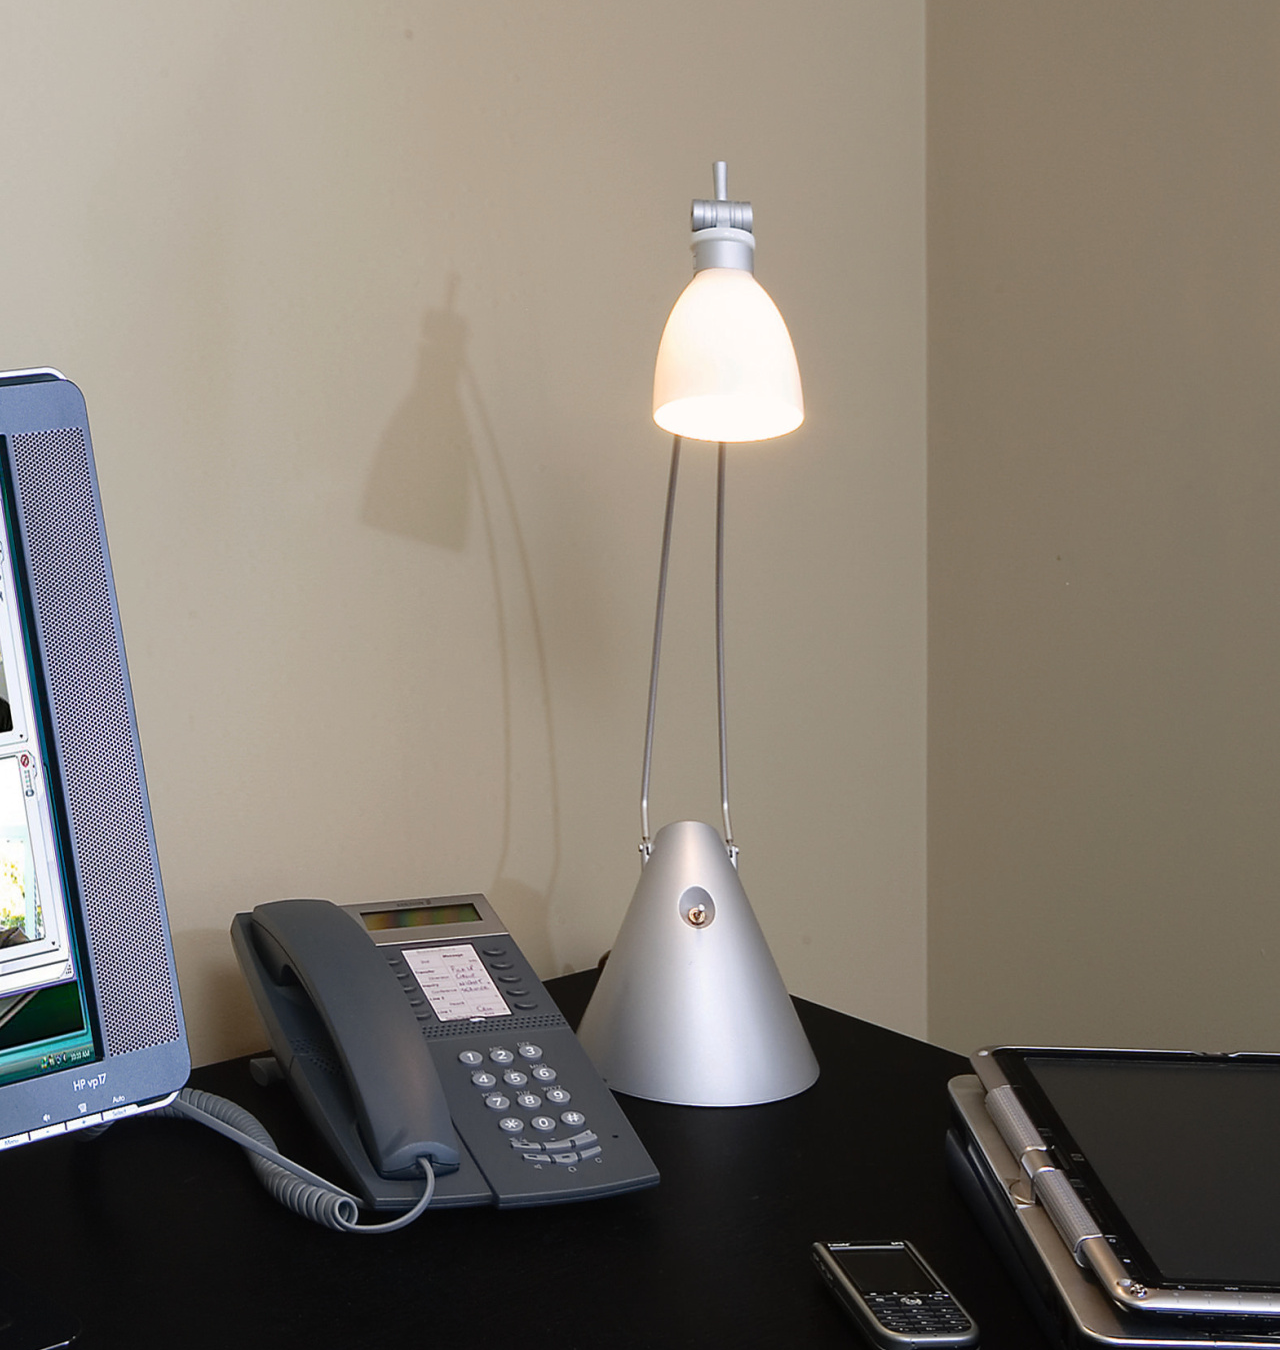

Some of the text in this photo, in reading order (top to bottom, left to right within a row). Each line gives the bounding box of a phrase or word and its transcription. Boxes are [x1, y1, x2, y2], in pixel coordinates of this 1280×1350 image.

[497, 1050, 507, 1060] 2
[525, 1046, 535, 1055] 3
[467, 1052, 474, 1061] 1
[539, 1068, 549, 1077] 6
[479, 1074, 488, 1083] 4
[510, 1073, 520, 1082] 5
[73, 1080, 86, 1091] HP
[553, 1090, 563, 1099] 9
[492, 1097, 501, 1106] 7
[524, 1095, 535, 1105] 8
[538, 1118, 548, 1127] 0
